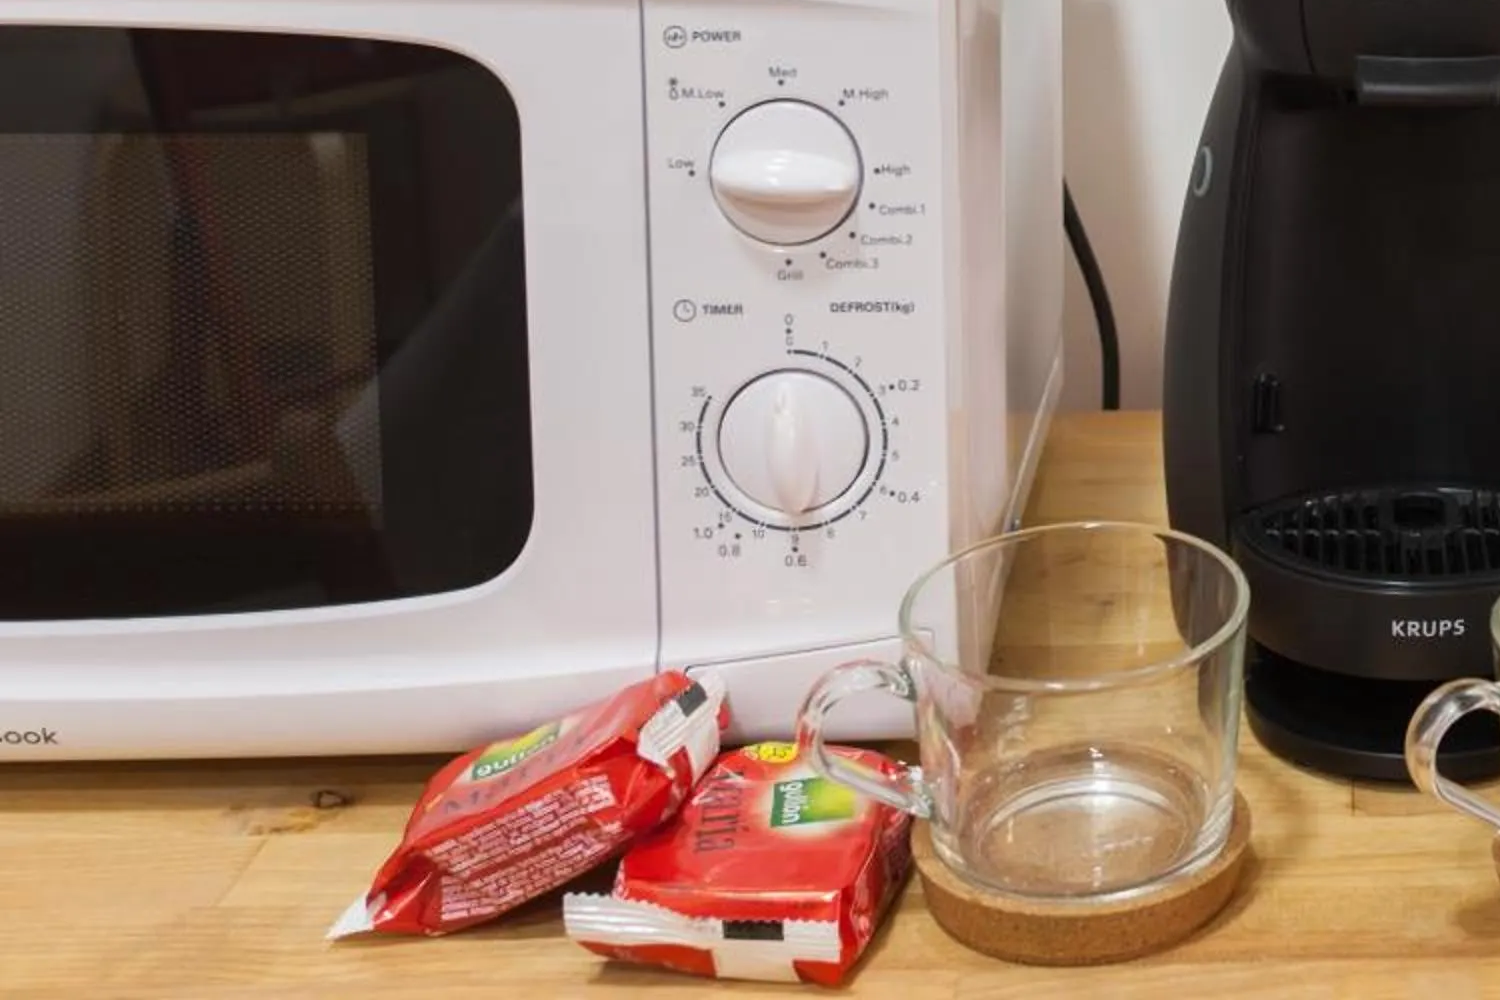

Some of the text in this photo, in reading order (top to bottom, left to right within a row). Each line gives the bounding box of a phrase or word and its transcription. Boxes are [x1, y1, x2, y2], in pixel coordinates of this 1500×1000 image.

[691, 30, 742, 43] POWER
[768, 66, 797, 78] Med
[667, 158, 695, 170] Low
[881, 163, 911, 178] High
[776, 269, 804, 281] Grill
[701, 303, 744, 316] TIMER
[829, 301, 915, 316] DEFROST(kg)
[897, 378, 921, 393] 0.2
[891, 416, 900, 427] 4
[897, 490, 921, 504] 0.4
[1391, 619, 1465, 637] KRUPS
[0, 727, 59, 745] ook
